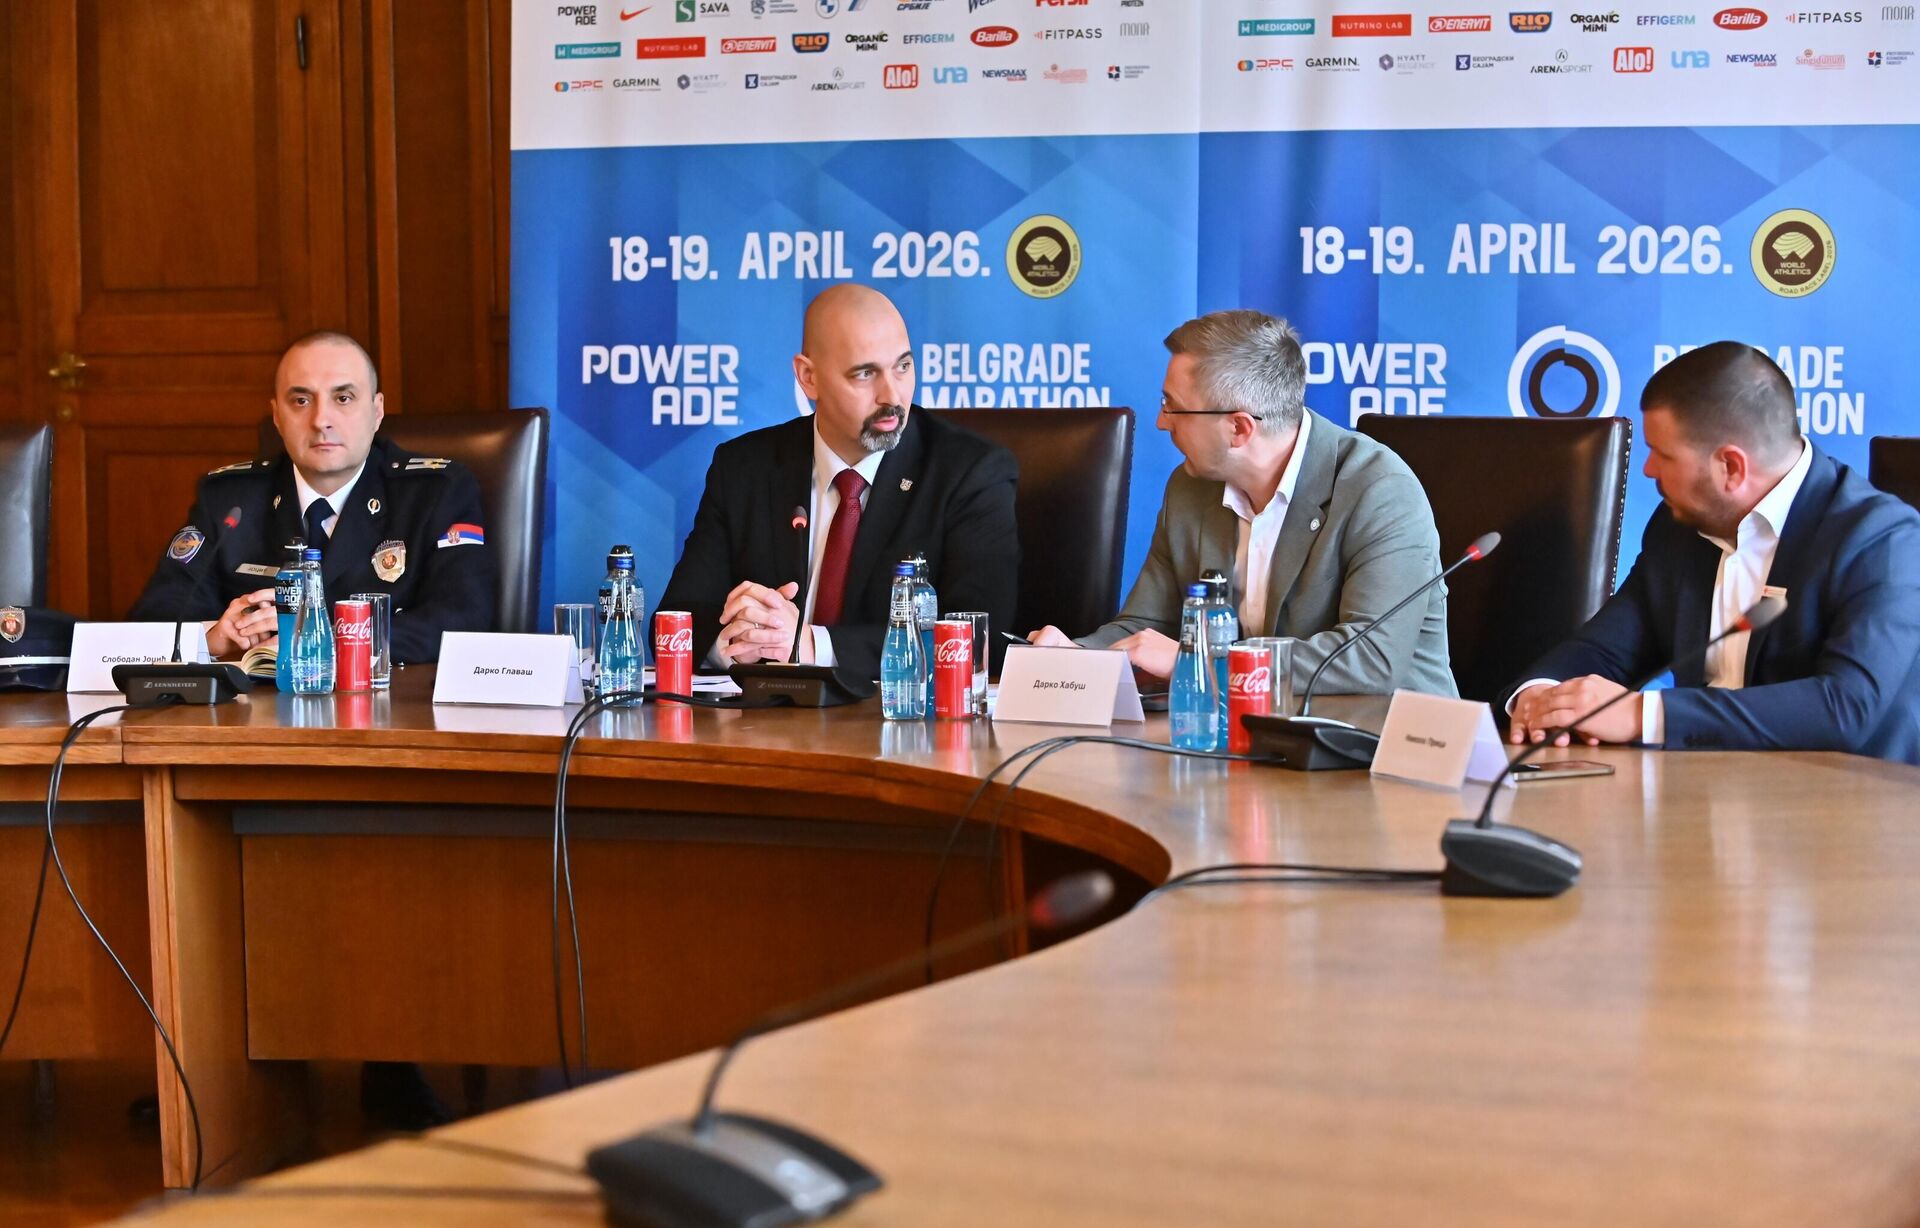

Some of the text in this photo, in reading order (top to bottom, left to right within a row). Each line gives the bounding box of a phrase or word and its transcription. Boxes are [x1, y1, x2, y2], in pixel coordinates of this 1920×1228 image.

[557, 5, 597, 17] POWER
[700, 2, 730, 13] SAVA
[575, 16, 597, 26] ADE
[1511, 14, 1550, 26] RIO
[1570, 13, 1620, 24] ORGANIC
[1636, 15, 1696, 26] EFFIGERM
[1719, 12, 1762, 25] Barilla
[1798, 11, 1863, 23] FITPASS
[1256, 22, 1312, 32] MEDIGROUP
[1340, 21, 1404, 30] NUTRINO LAB
[1446, 17, 1490, 30] ENERVIT
[845, 33, 889, 44] ORGANIC
[903, 33, 955, 45] EFFIGERM
[975, 30, 1013, 43] Barilla
[1045, 28, 1103, 40] FITPASS
[737, 38, 776, 52] ENERVIT
[794, 35, 827, 46] RIO
[1397, 54, 1426, 62] HYATT
[1614, 49, 1653, 72] Alo!
[1671, 50, 1710, 69] una
[1726, 53, 1777, 64] NEWSMAX
[885, 66, 917, 88] Alo!
[933, 66, 969, 84] una
[982, 68, 1027, 79] NEWSMAX
[1299, 222, 1733, 275] 18-19. APRIL 2026.
[608, 230, 991, 282] 18-19. APRIL 2026.
[1773, 268, 1812, 276] ATHLETICS
[1800, 281, 1818, 293] RACE
[1816, 262, 1832, 283] LABEL
[582, 344, 739, 385] POWER
[921, 343, 1091, 384] BELGRADE
[1301, 342, 1448, 385] OWER
[652, 387, 740, 426] ADE
[1350, 387, 1447, 429] ADE
[102, 655, 141, 664] Слободан
[473, 666, 533, 676] Дарко Главаш
[1033, 680, 1086, 691] Дарко Хабуш
